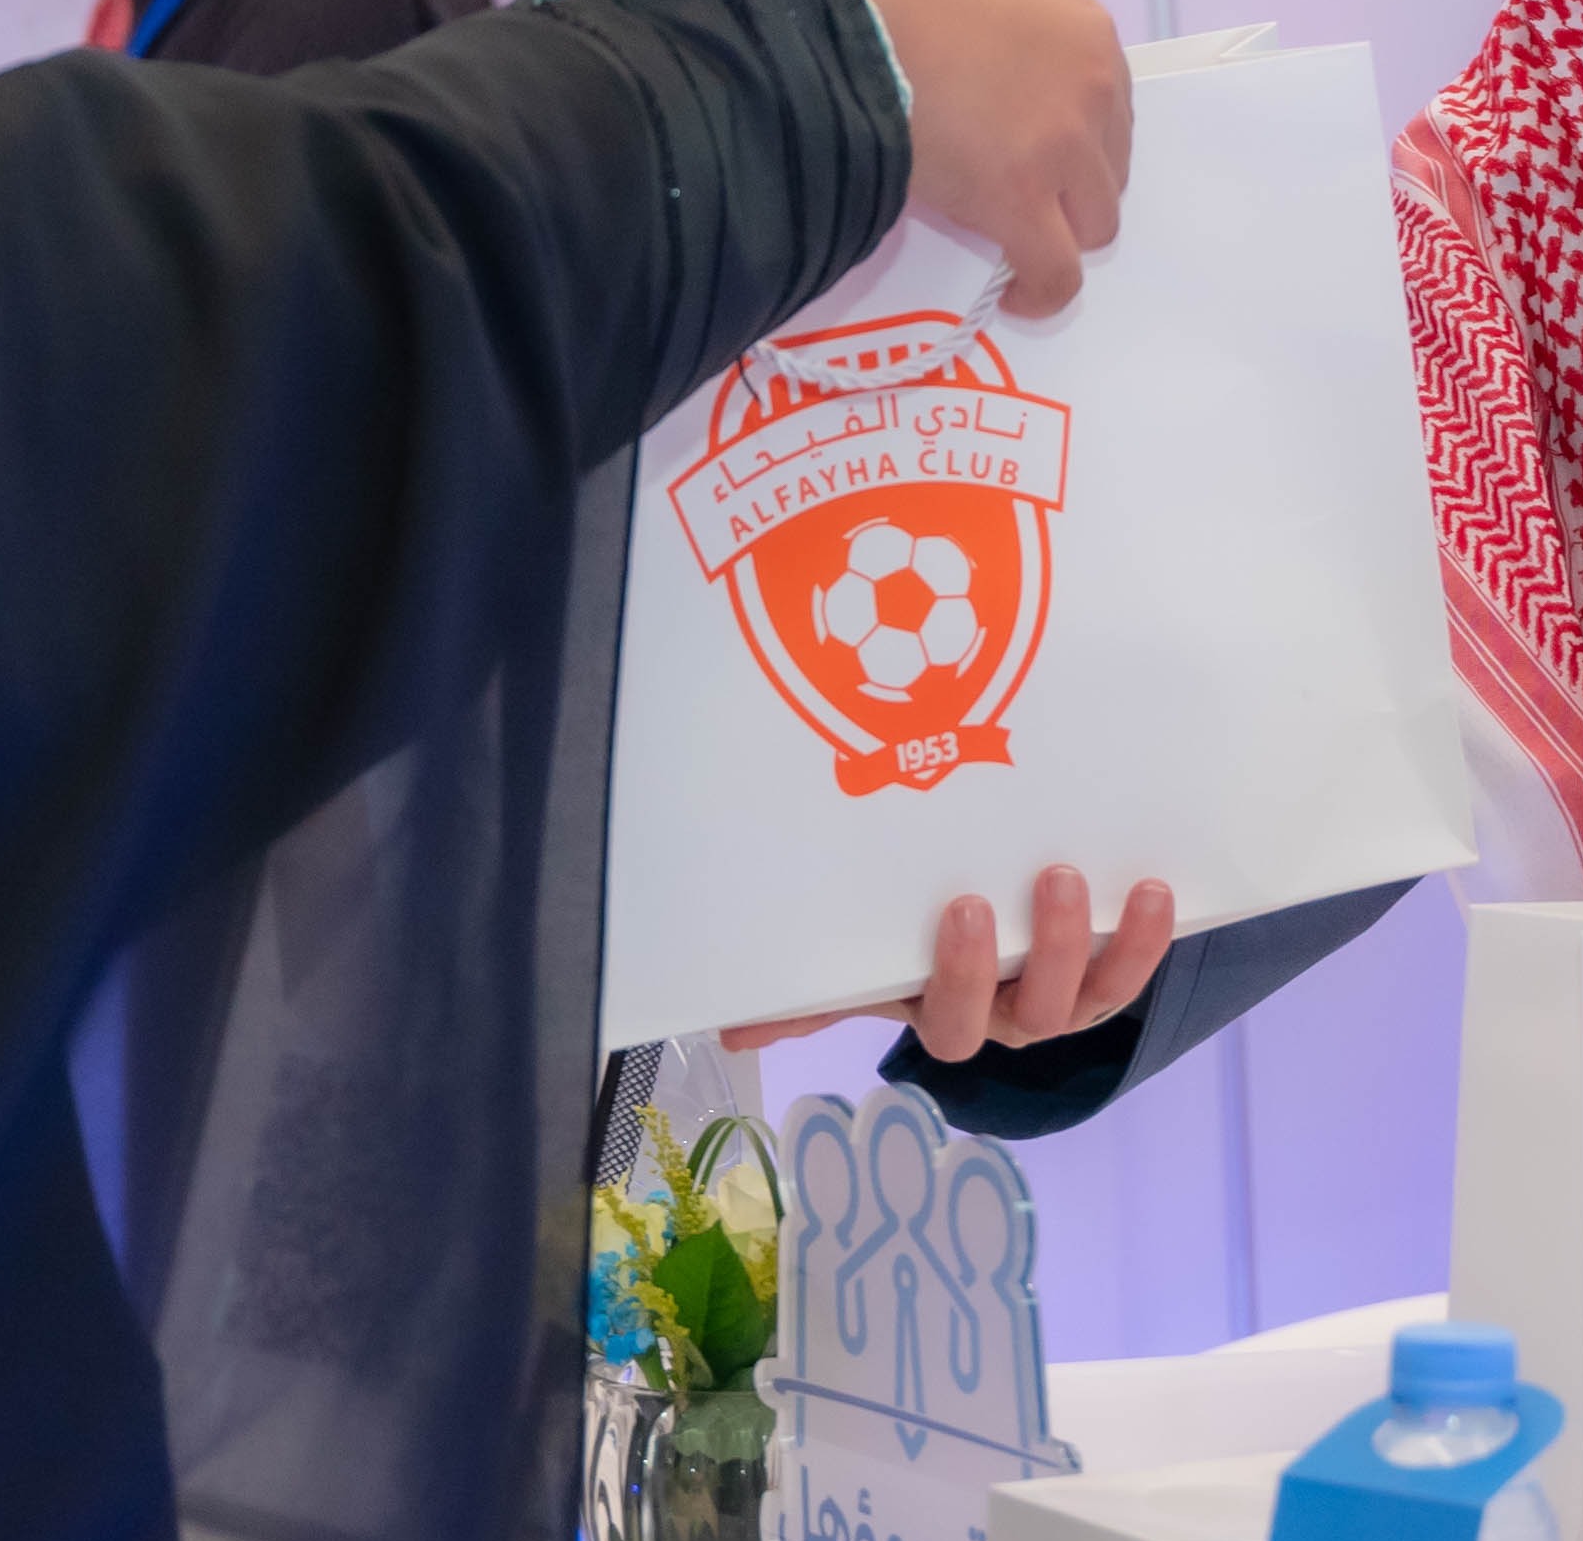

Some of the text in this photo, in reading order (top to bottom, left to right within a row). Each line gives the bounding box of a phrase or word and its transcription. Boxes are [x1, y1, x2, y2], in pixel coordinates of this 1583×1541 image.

[713, 393, 1028, 504] نادي الفيحاء
[727, 448, 1020, 543] ALFAYHA CLUB
[896, 730, 960, 773] 1953
